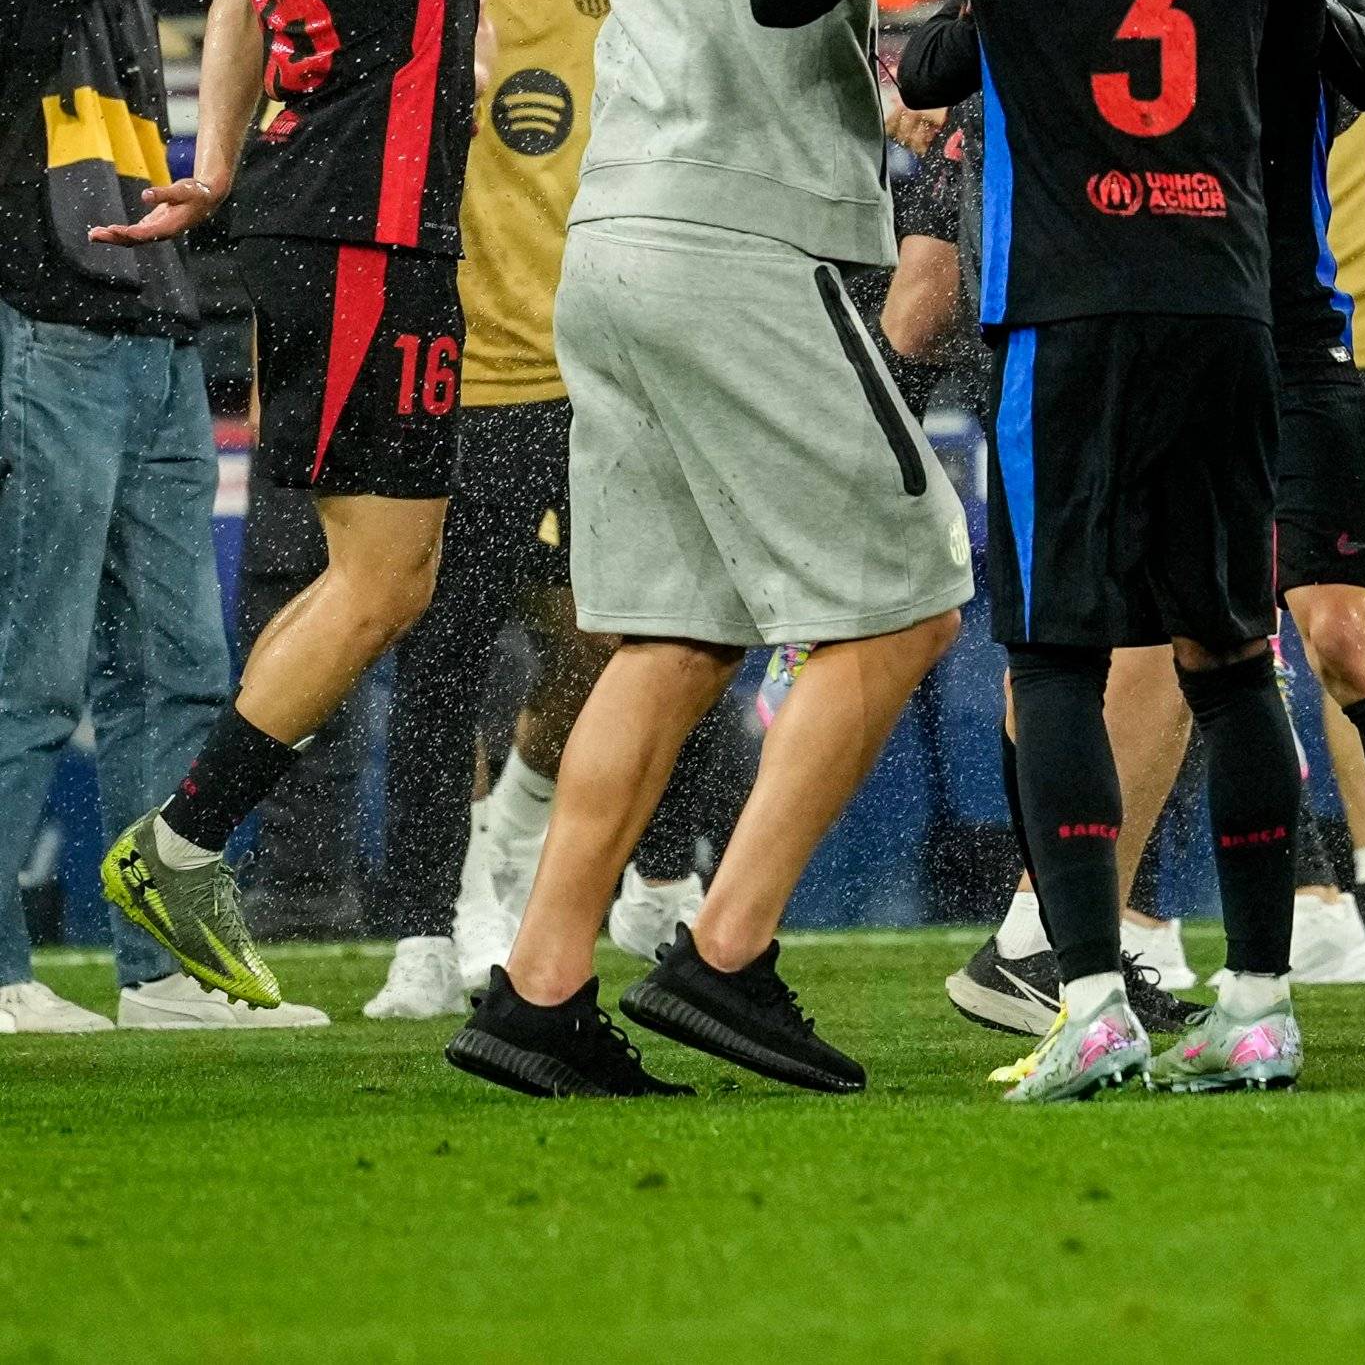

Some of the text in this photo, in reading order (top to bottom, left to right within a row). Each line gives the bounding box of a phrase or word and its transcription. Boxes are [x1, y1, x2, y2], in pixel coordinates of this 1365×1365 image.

[1145, 171, 1222, 193] UNHCR
[1149, 189, 1226, 210] ACNUR
[393, 333, 459, 416] 16
